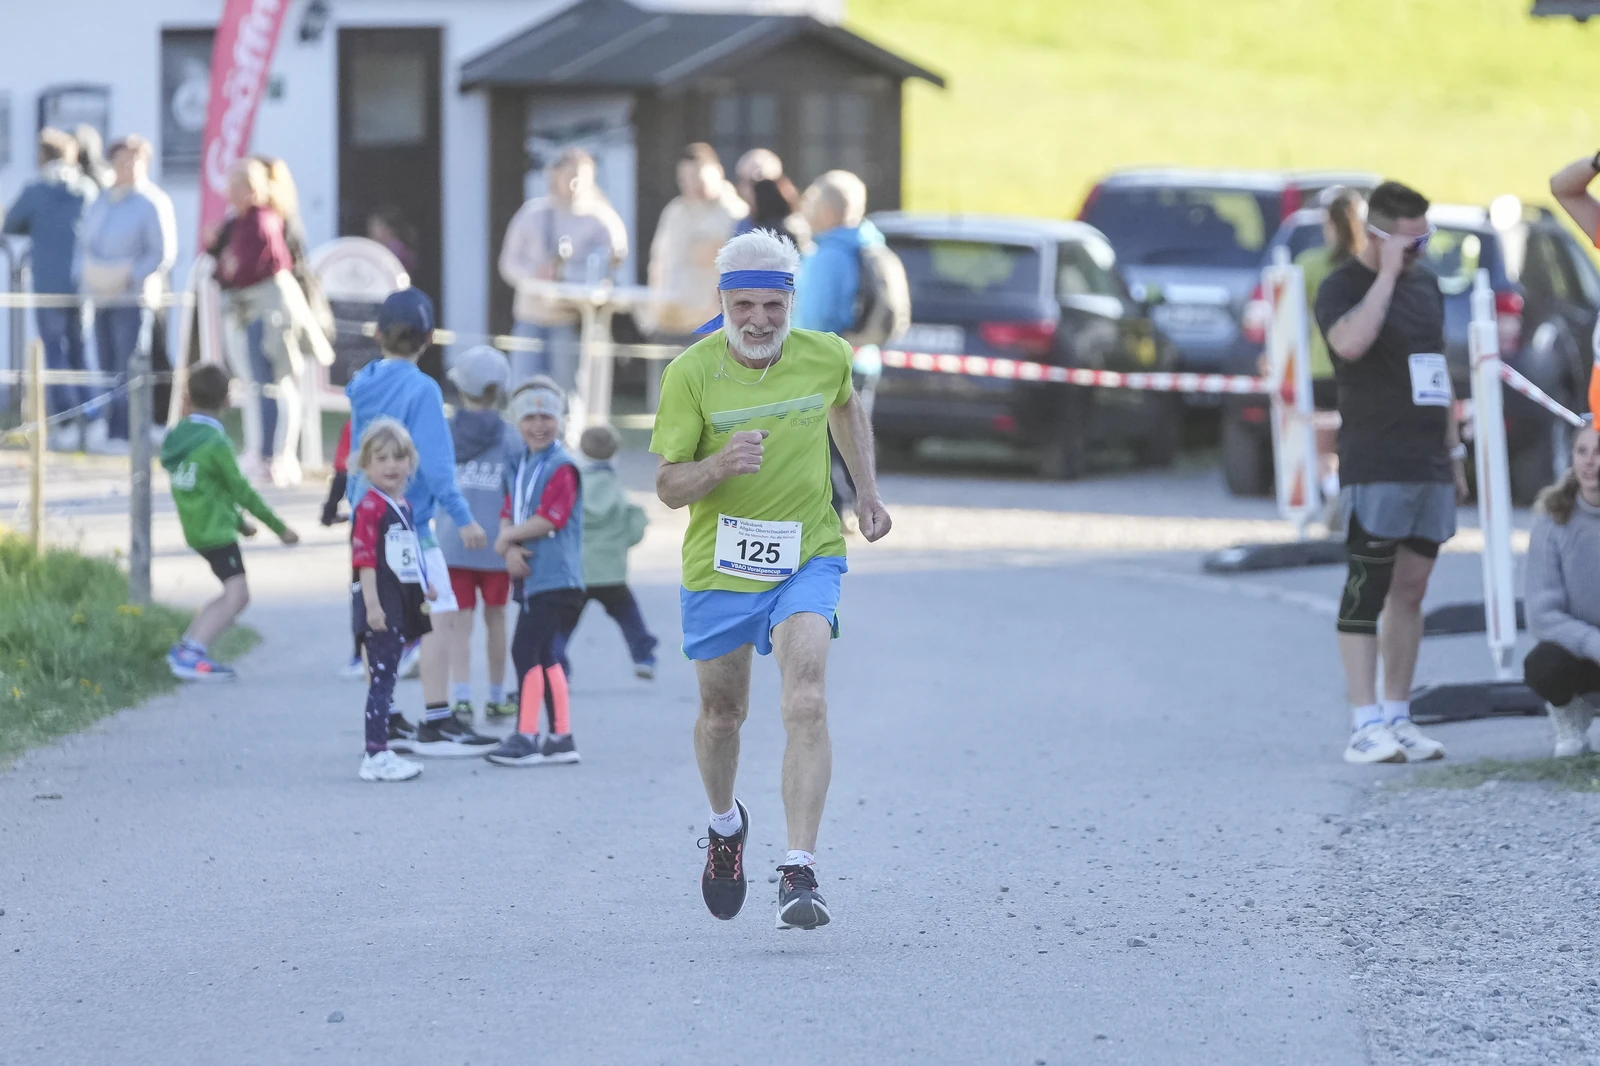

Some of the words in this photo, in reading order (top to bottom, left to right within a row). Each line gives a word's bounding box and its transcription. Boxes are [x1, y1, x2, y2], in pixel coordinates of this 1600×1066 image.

[740, 526, 789, 534] Allgäu-Oberschwaben
[736, 539, 781, 564] 125
[747, 566, 781, 574] Voralpencup
